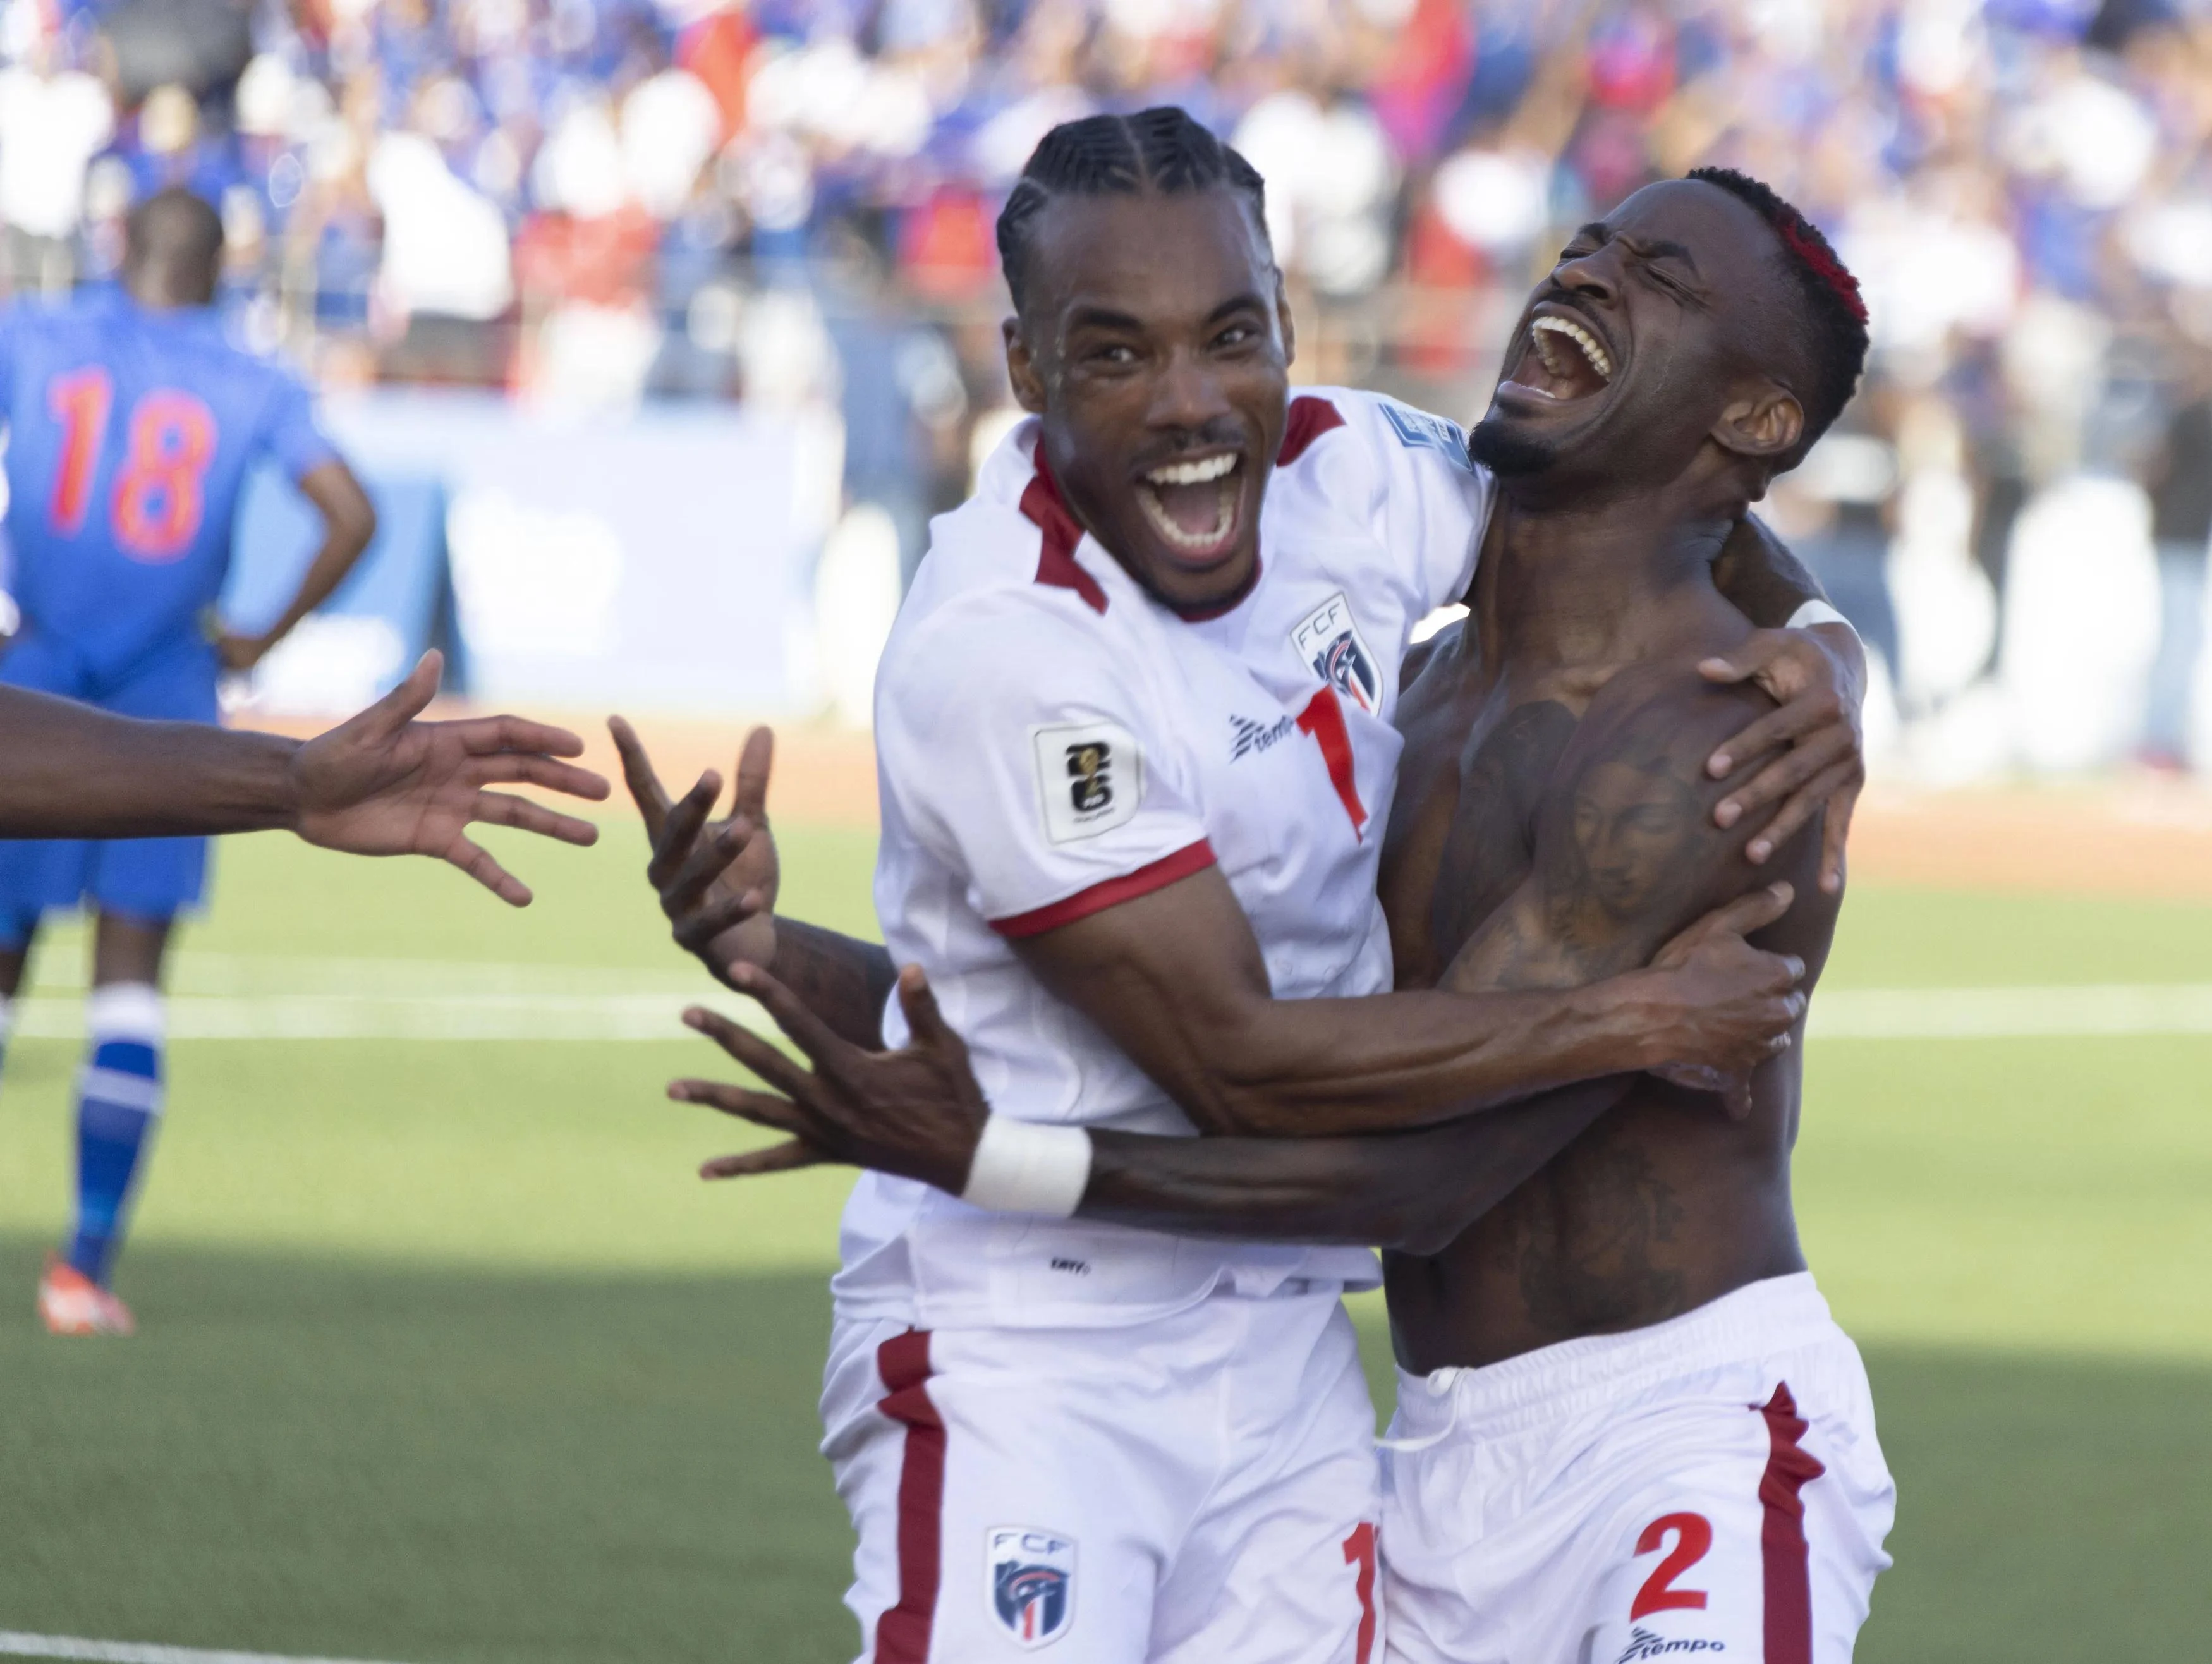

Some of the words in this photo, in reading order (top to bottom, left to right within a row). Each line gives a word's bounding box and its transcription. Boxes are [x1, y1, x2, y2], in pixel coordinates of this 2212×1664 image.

[48, 364, 218, 562] 18
[1297, 602, 1340, 650] FCF
[994, 1533, 1071, 1555] FCF
[1630, 1512, 1713, 1623] 2
[1342, 1521, 1381, 1664] 1
[1641, 1638, 1725, 1660] tempo
